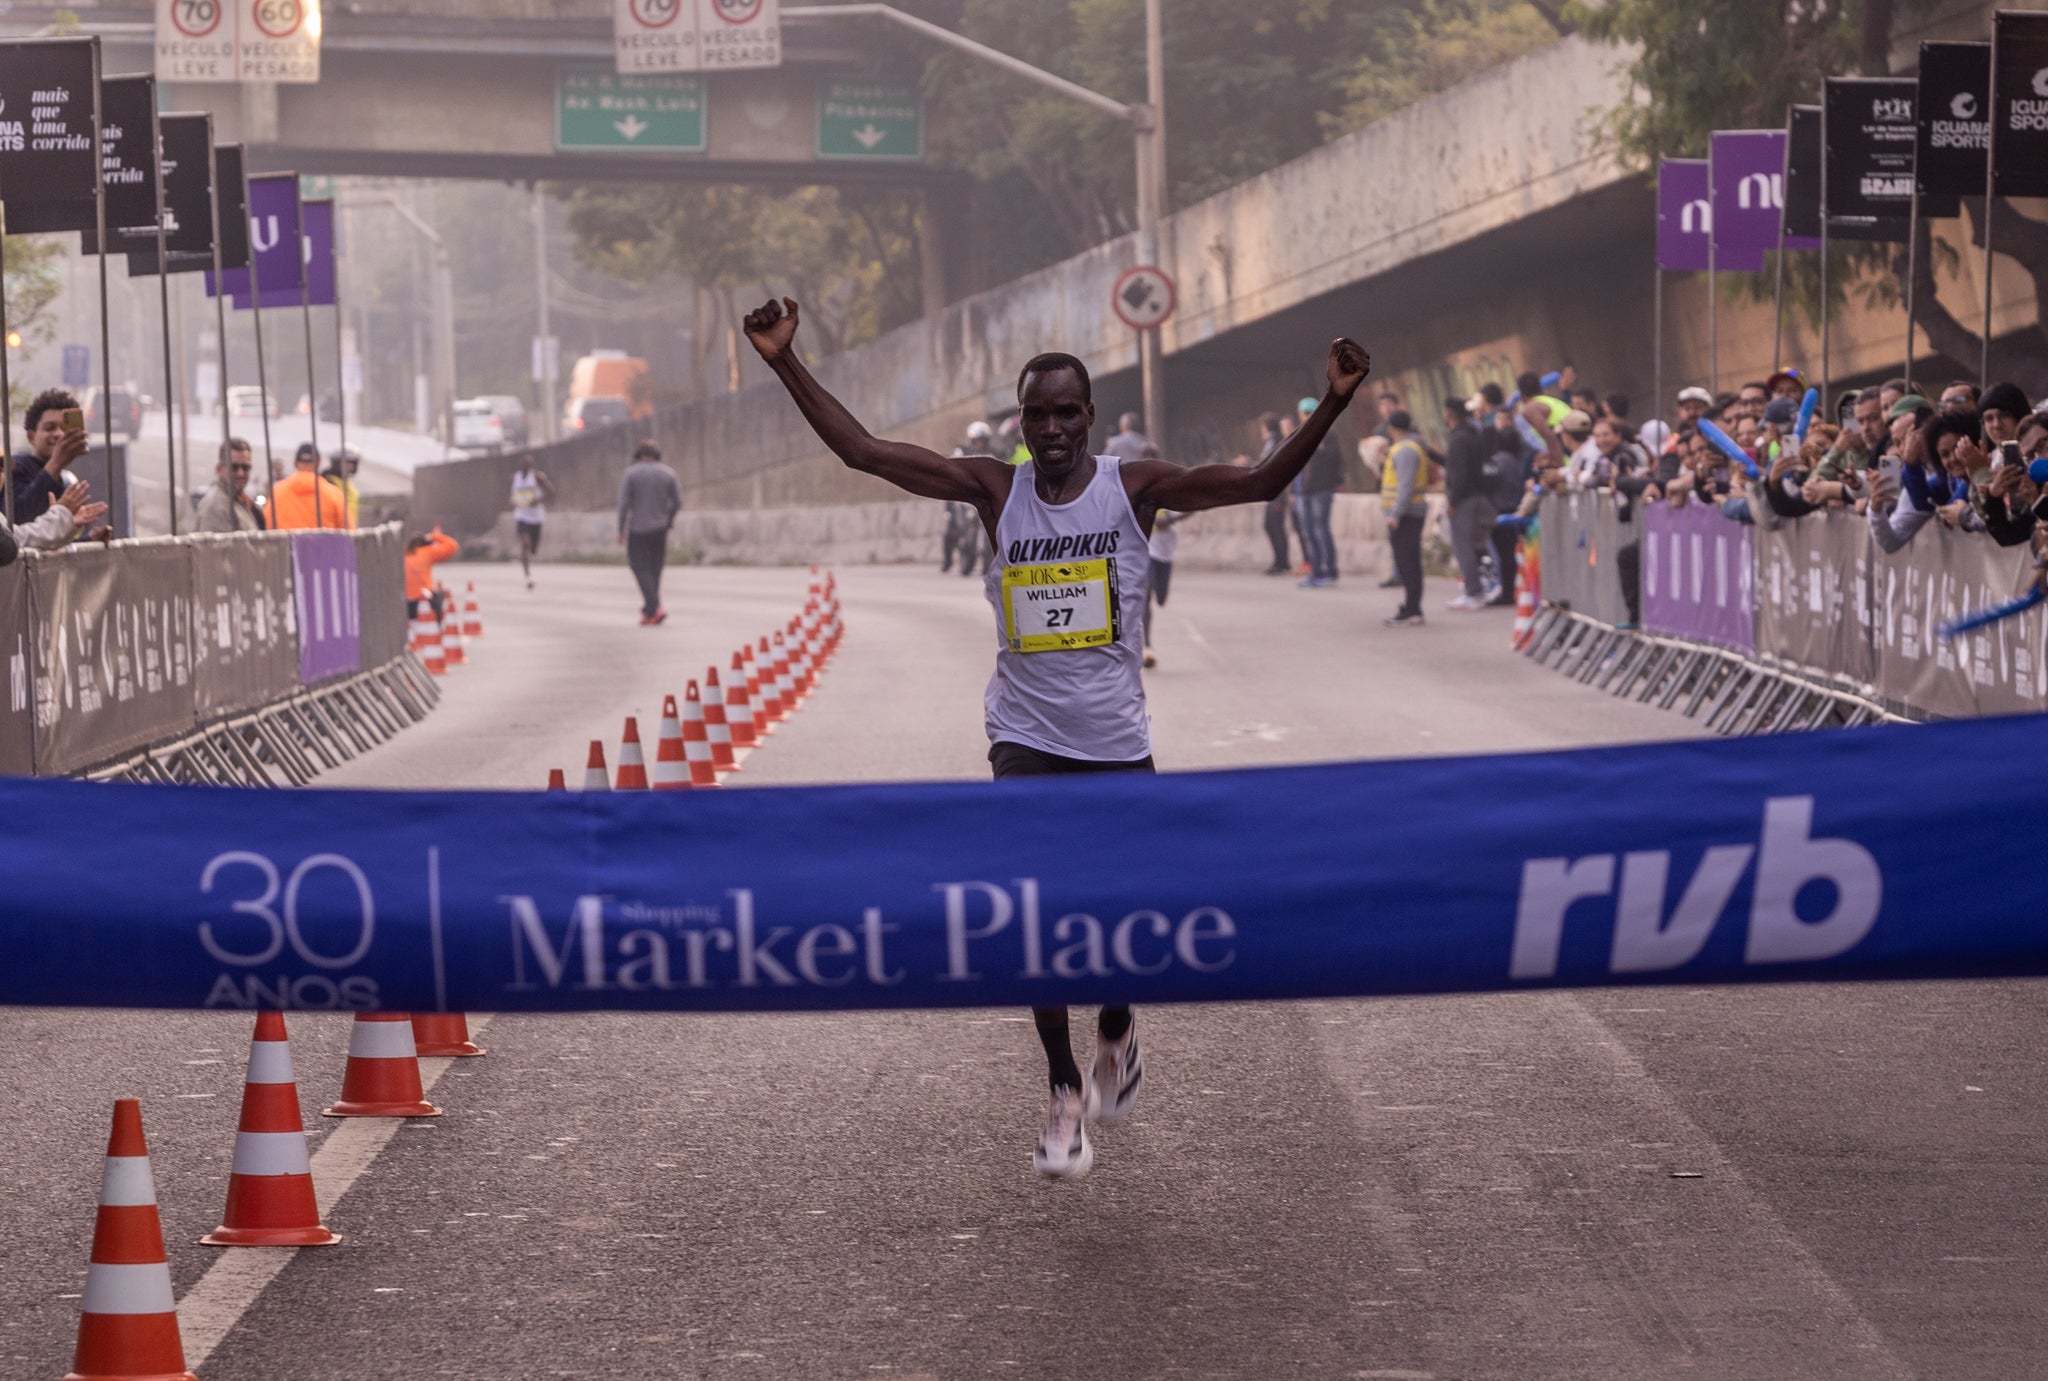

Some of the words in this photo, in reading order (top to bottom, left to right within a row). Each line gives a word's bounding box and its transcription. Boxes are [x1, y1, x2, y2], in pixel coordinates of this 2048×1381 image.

[261, 0, 298, 21] 60
[634, 50, 681, 67] LEVE
[705, 46, 777, 63] PESADO
[172, 60, 217, 75] LEVE
[243, 61, 315, 75] PESADO
[32, 87, 69, 103] mais
[31, 105, 61, 122] que
[32, 122, 66, 135] uma
[102, 124, 123, 139] ais
[32, 134, 90, 151] corrida
[1008, 530, 1120, 564] OLYMPIKUS
[1026, 586, 1087, 601] WILLIAM
[1046, 608, 1074, 627] 27
[1509, 796, 1883, 979] rvb
[199, 851, 376, 968] 30
[498, 888, 906, 990] Market
[930, 878, 1238, 981] Place
[203, 973, 381, 1011] ANOS
